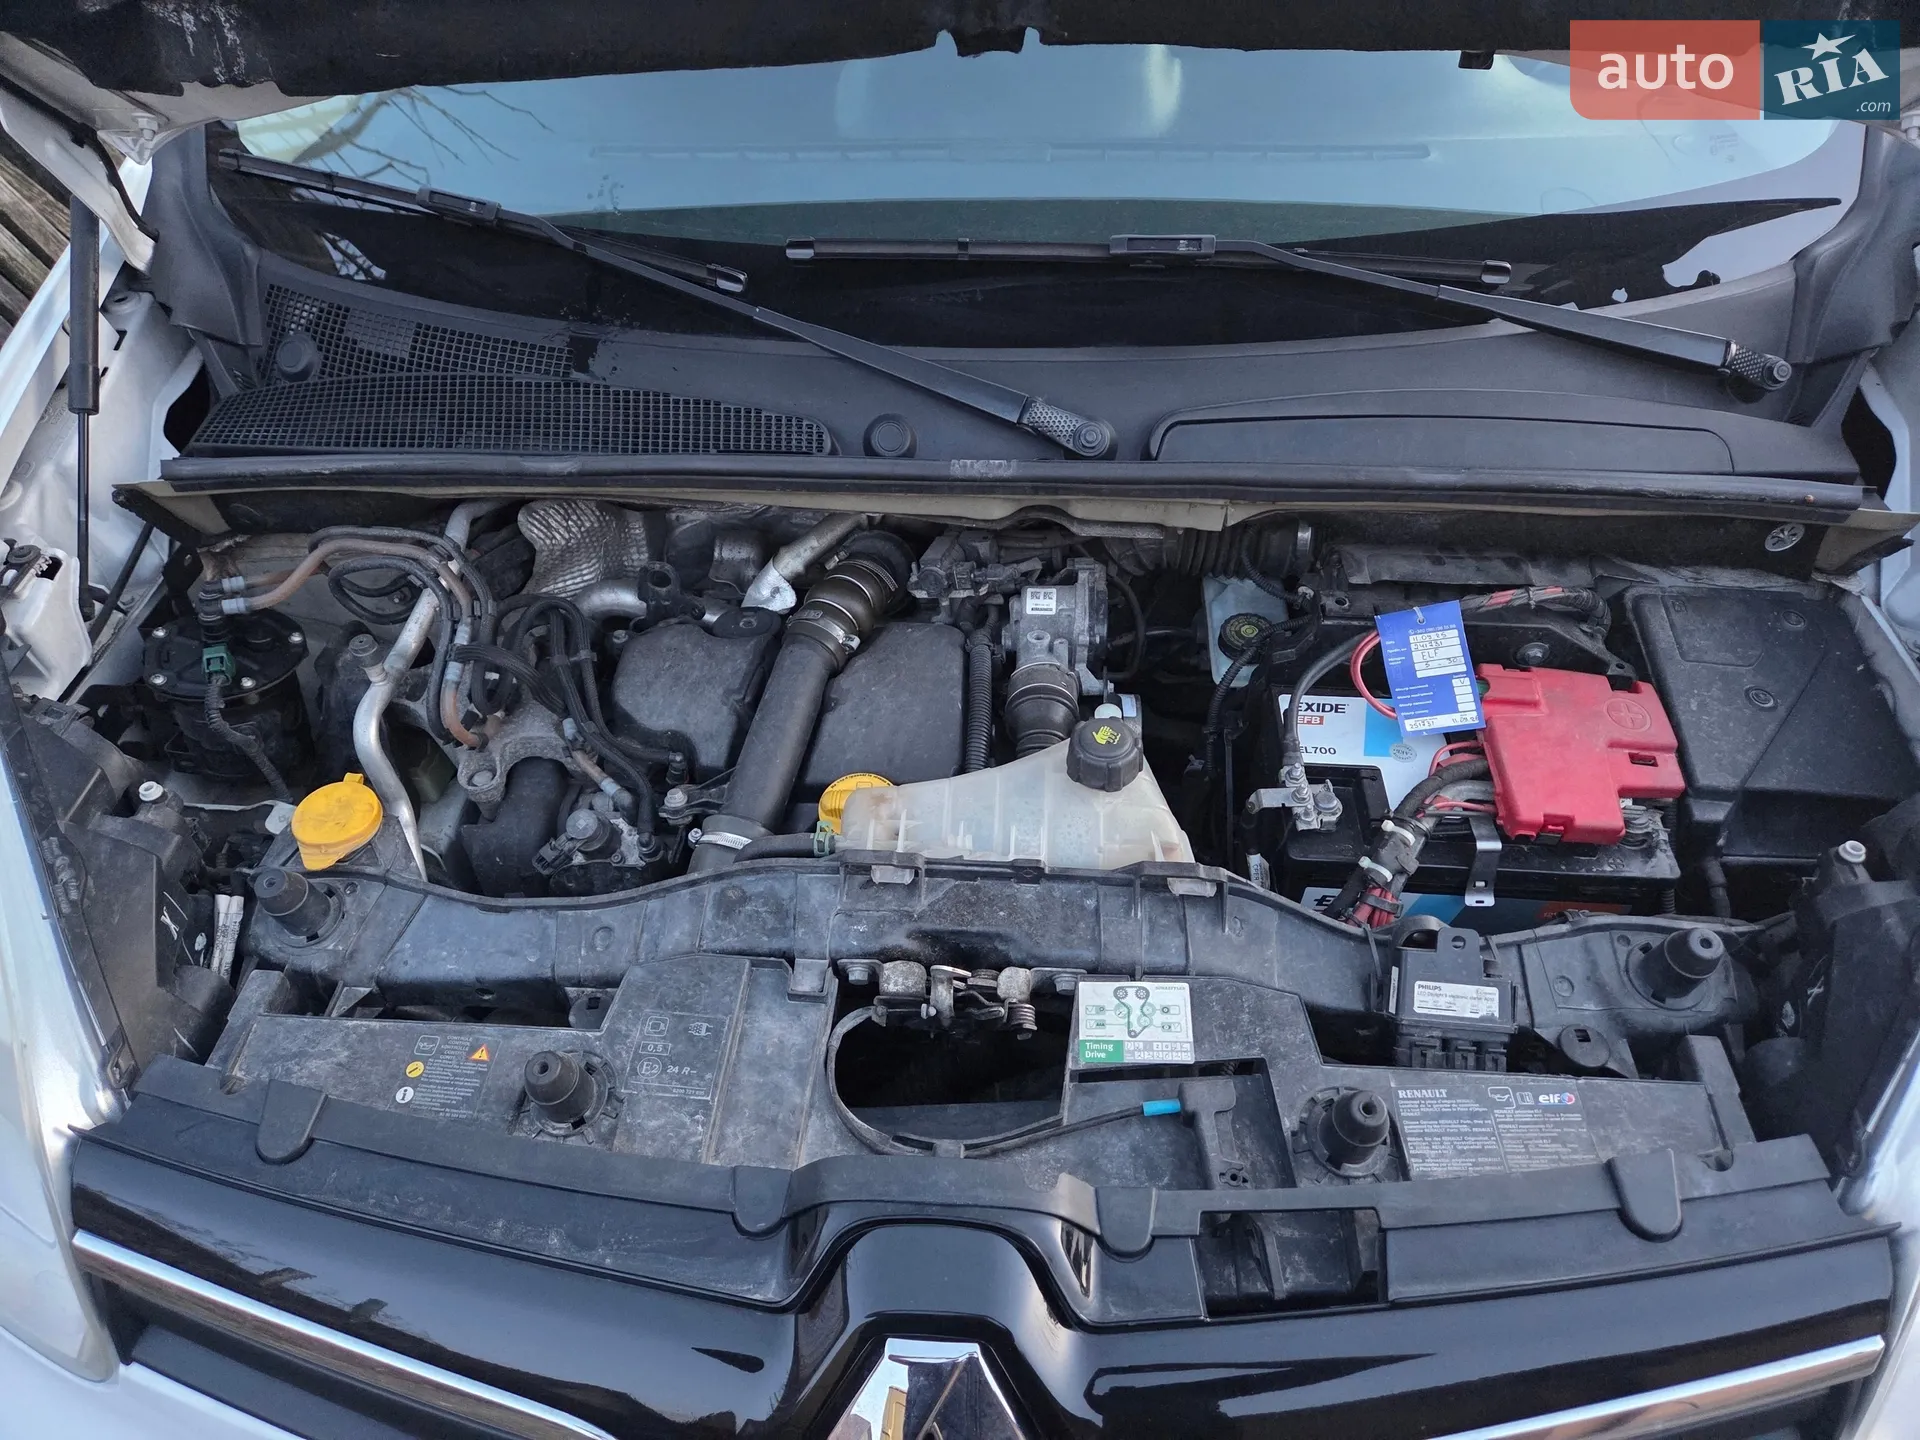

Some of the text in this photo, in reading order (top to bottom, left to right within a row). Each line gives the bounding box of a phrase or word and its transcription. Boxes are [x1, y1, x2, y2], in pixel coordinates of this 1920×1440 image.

[1421, 649, 1440, 661] ELF
[647, 1044, 664, 1052] 0,5
[1085, 1042, 1114, 1052] Timing
[1085, 1051, 1106, 1059] Drive
[641, 1061, 659, 1075] E2
[667, 1065, 679, 1073] 24
[1397, 1089, 1447, 1098] RENAULT
[1538, 1094, 1561, 1103] elf
